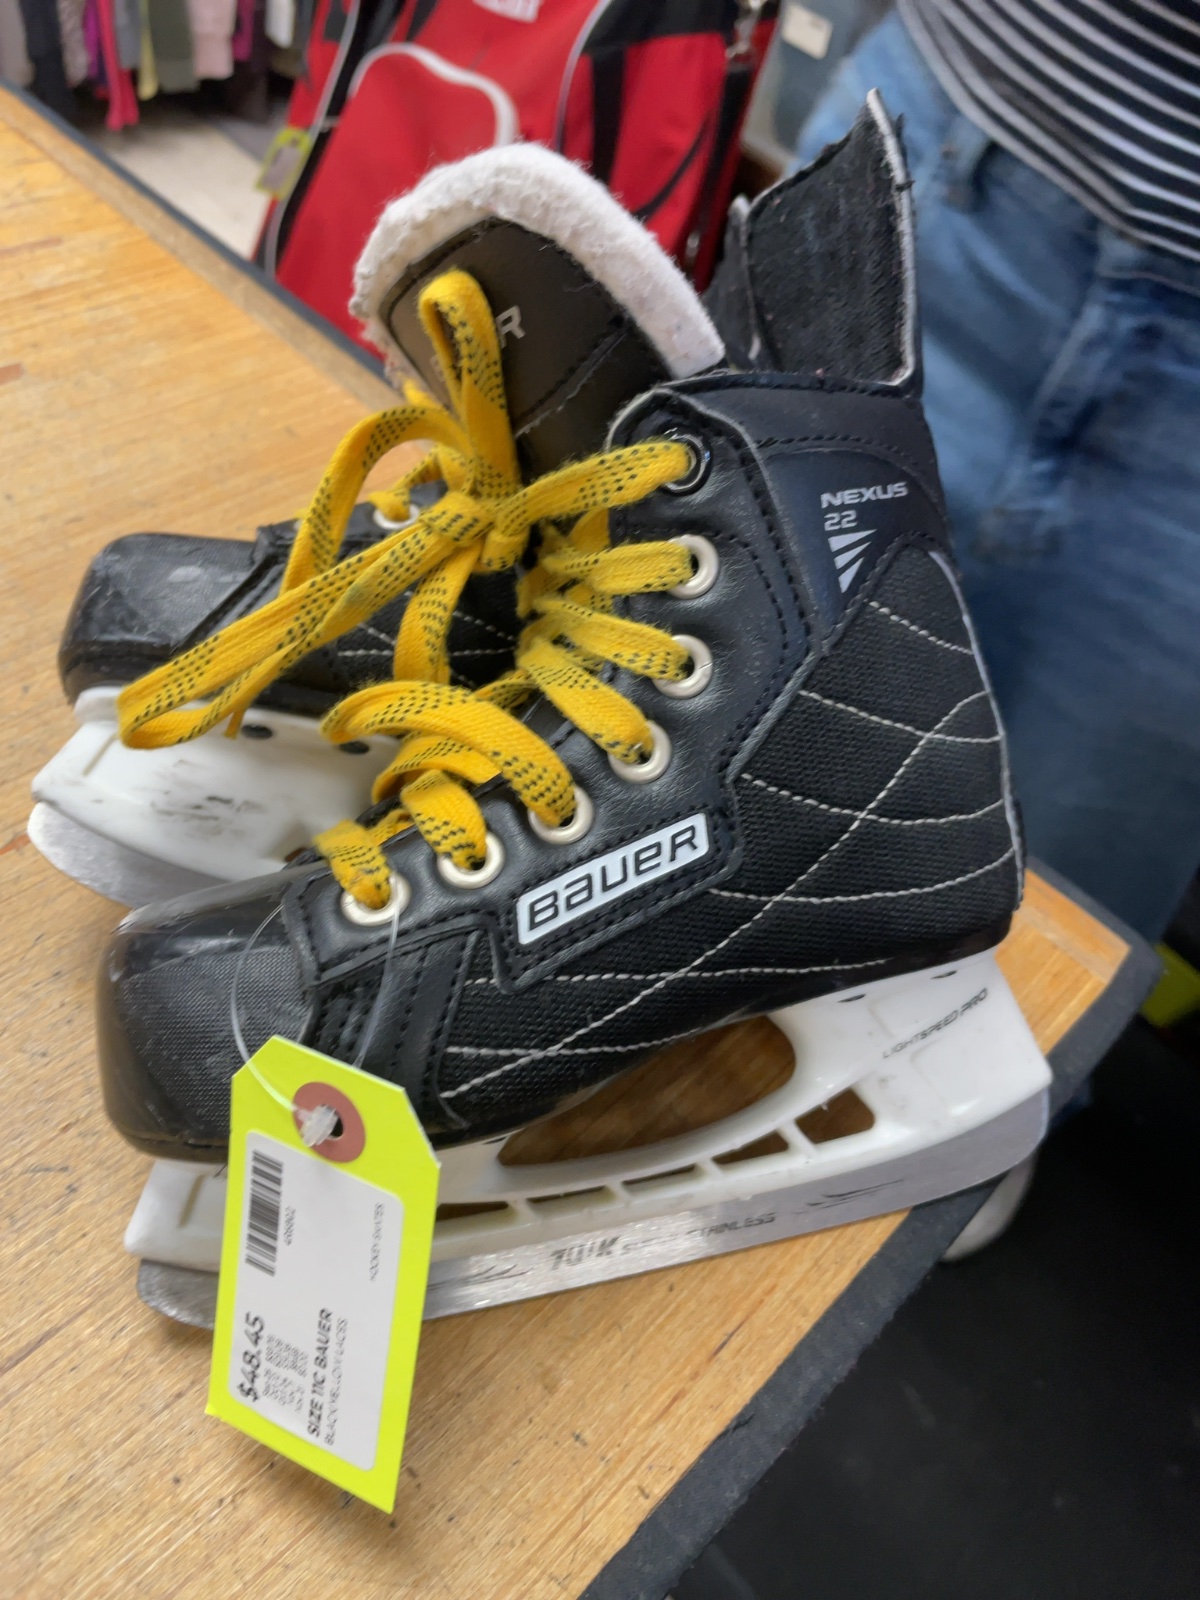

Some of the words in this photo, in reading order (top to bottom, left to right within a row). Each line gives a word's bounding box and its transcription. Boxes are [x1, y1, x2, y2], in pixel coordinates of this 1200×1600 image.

[821, 481, 909, 509] NEXUS
[824, 510, 858, 531] 22
[882, 1009, 958, 1059] LIGHTSPEED
[960, 987, 988, 1016] PRO
[236, 1311, 265, 1403] $48.45
[314, 1307, 333, 1370] BAUER
[311, 1371, 326, 1397] 11C
[307, 1399, 324, 1438] SIZE
